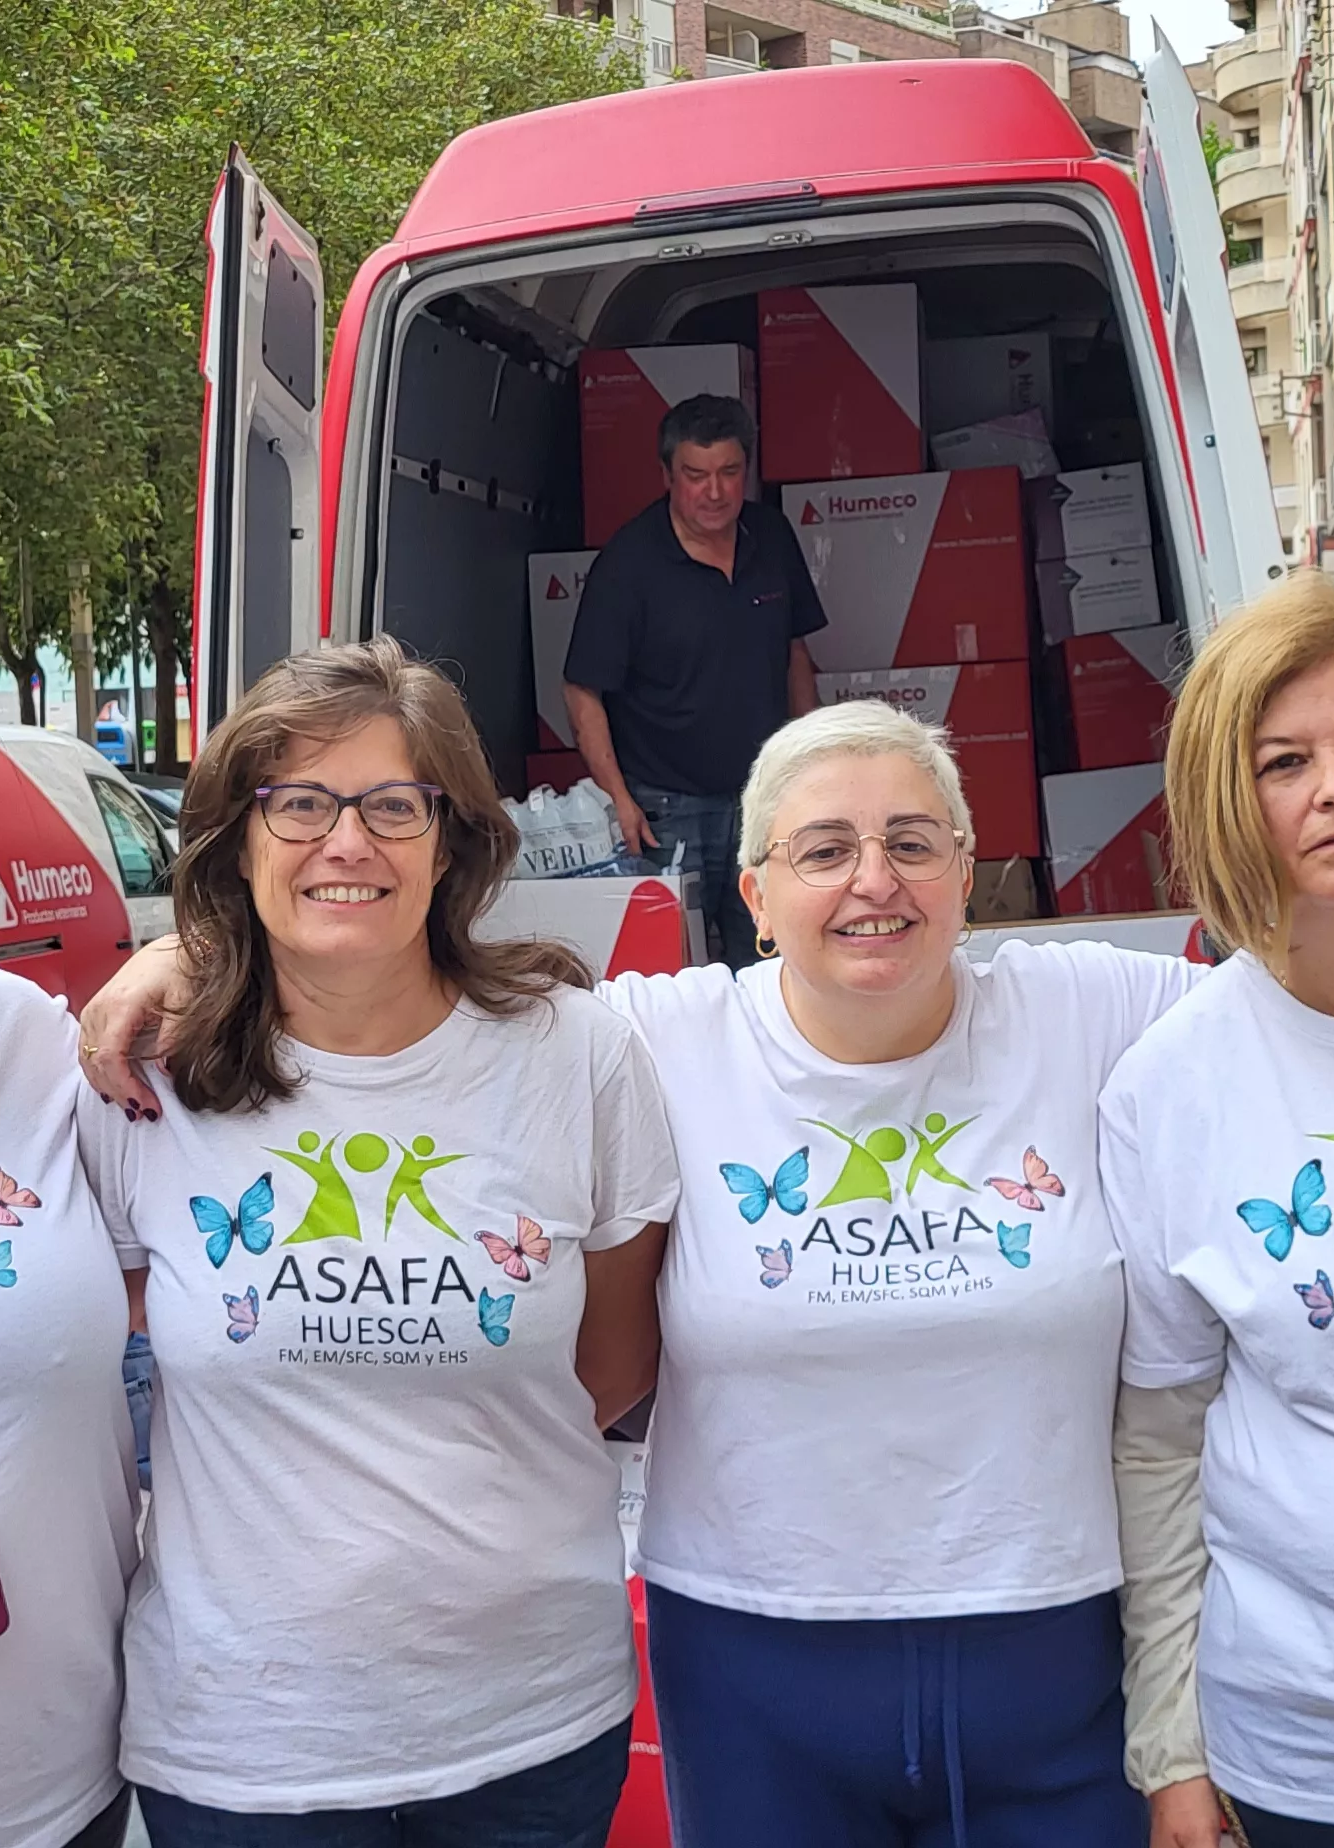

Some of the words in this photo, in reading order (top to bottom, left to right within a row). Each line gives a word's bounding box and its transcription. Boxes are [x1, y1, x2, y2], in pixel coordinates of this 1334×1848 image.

[828, 493, 918, 515] Humeco
[10, 860, 93, 903] Humeco
[800, 1206, 994, 1257] ASAFA
[266, 1254, 476, 1305] ASAFA
[832, 1254, 970, 1286] HUESCA
[808, 1290, 836, 1305] FM,
[909, 1284, 947, 1299] SQM
[965, 1276, 994, 1294] EHS
[301, 1315, 446, 1345] HUESCA
[279, 1348, 309, 1366] FM,
[314, 1349, 379, 1366] EM/SFC,
[383, 1351, 421, 1366] SQM
[425, 1353, 435, 1367] y
[439, 1350, 468, 1364] EHS
